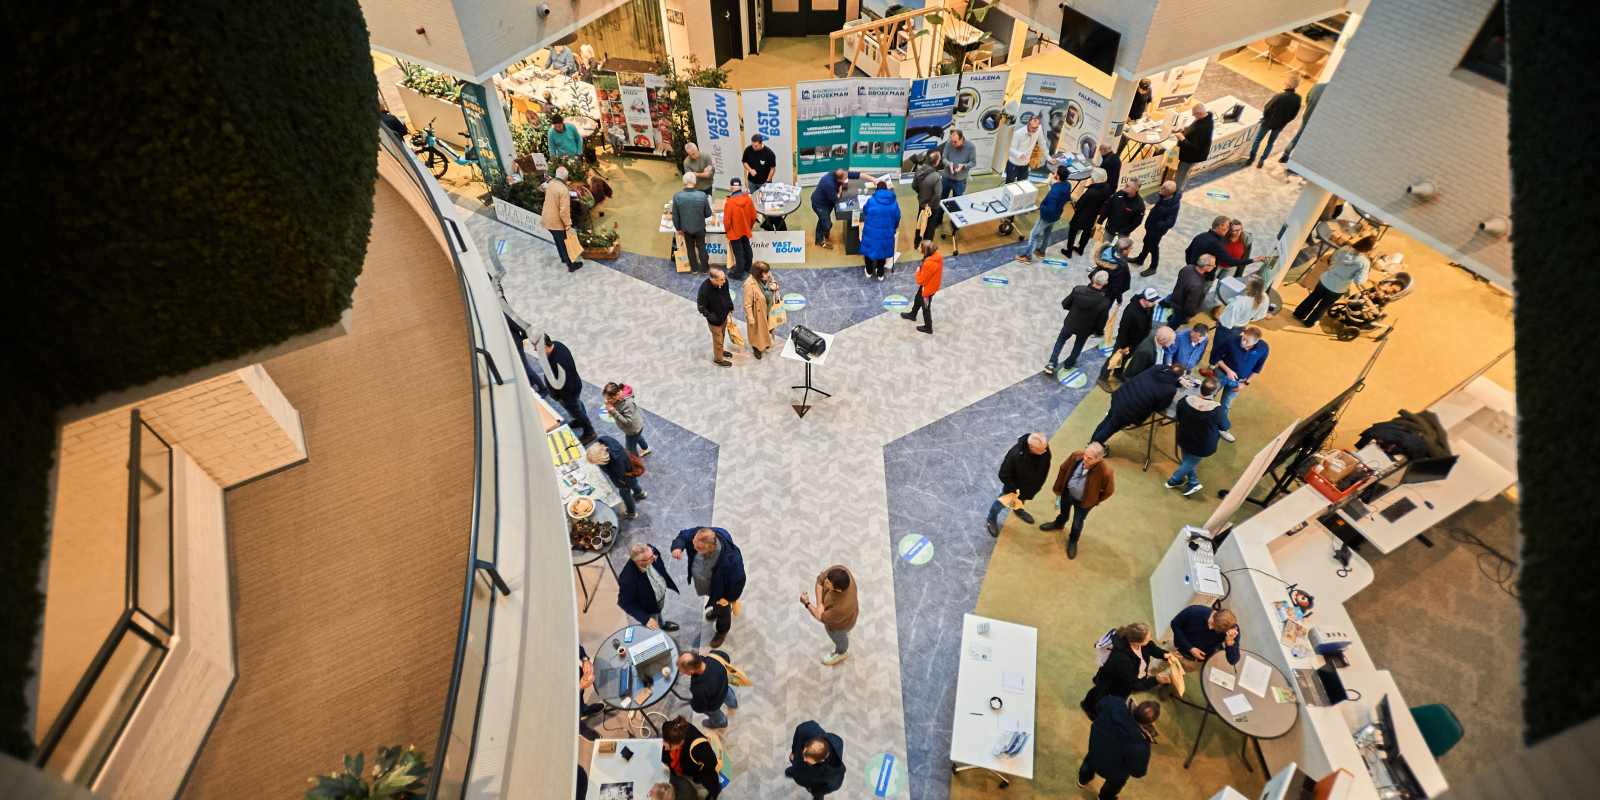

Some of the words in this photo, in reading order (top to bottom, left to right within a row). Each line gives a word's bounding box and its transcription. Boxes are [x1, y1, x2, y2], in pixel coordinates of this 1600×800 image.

[932, 80, 950, 89] drok
[1078, 91, 1102, 108] FALKENA
[706, 109, 719, 140] VAST
[714, 93, 729, 137] BOUW
[768, 93, 780, 136] BOUW
